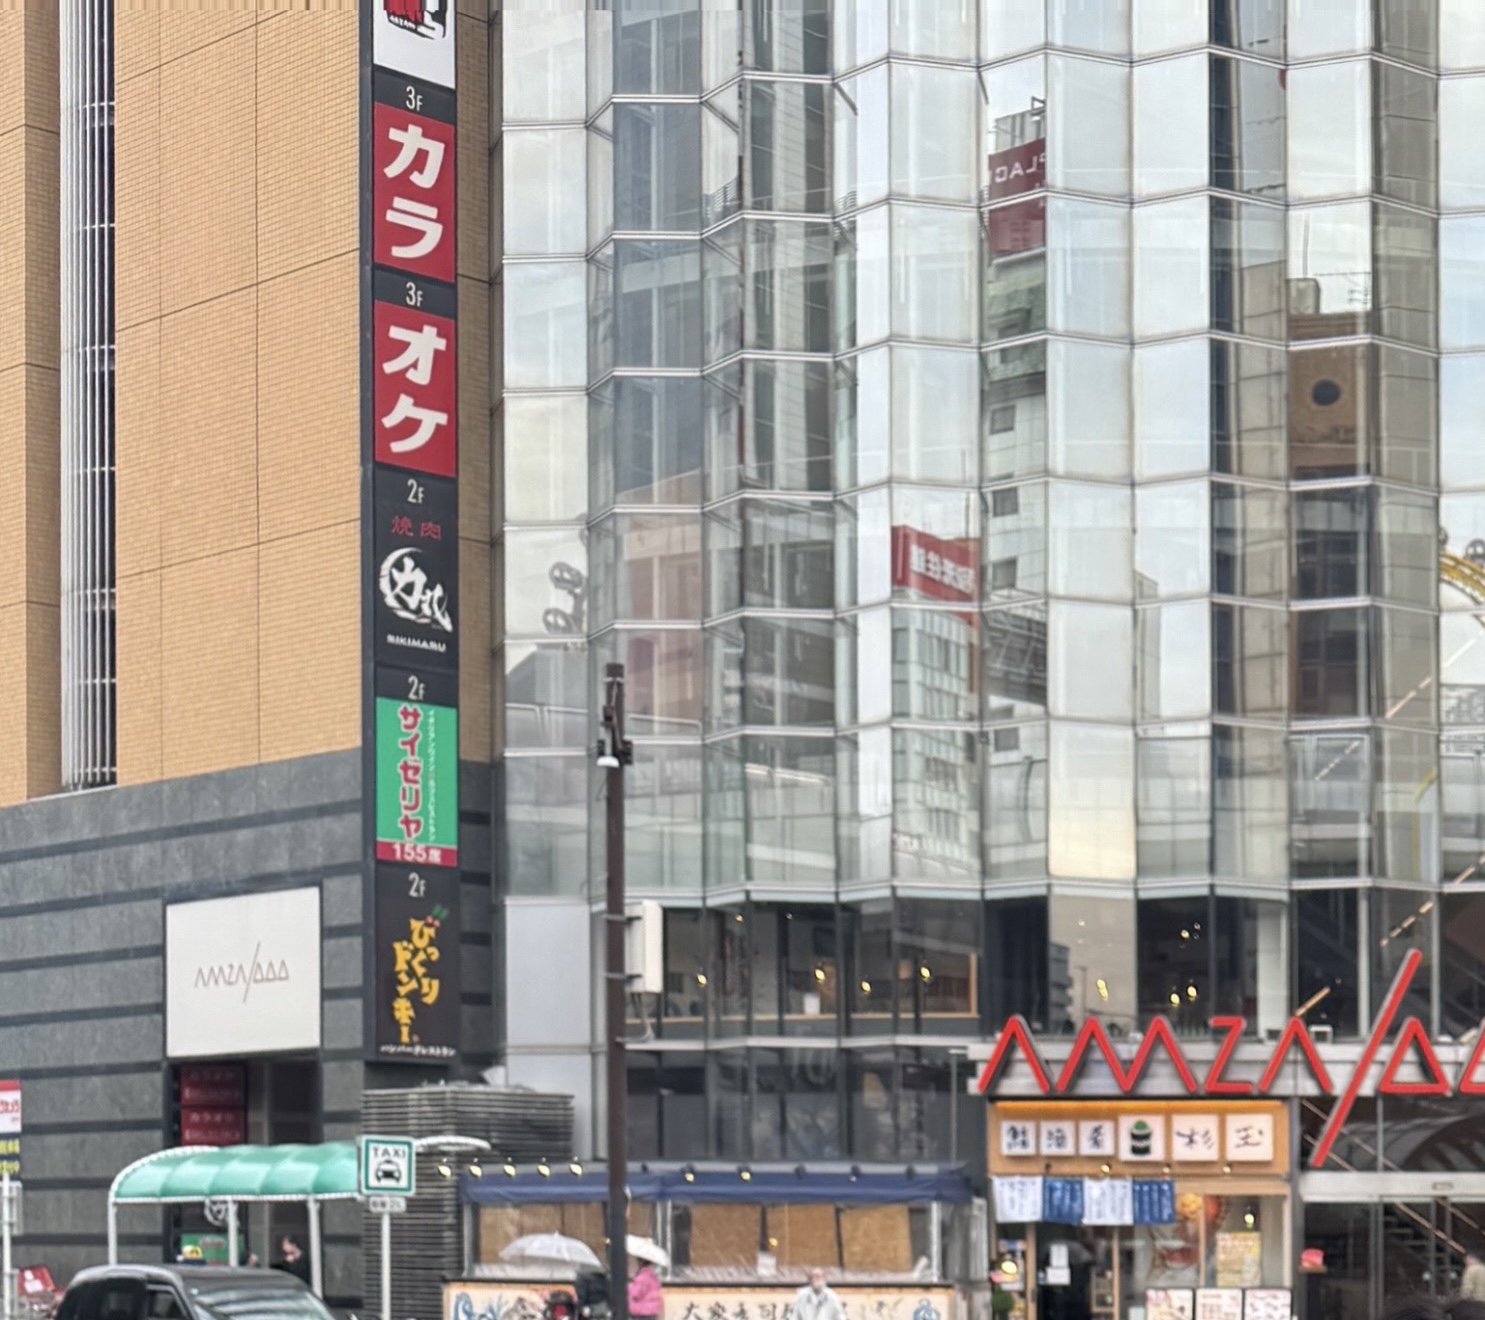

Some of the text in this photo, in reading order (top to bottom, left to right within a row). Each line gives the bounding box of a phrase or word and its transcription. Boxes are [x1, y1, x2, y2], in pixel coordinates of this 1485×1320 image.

[405, 85, 423, 111] 3F
[406, 281, 423, 307] 3F
[407, 478, 425, 504] 2F
[408, 675, 425, 700] 2F
[398, 704, 423, 841] サイゼリヤ
[409, 872, 426, 898] 2F
[373, 1147, 406, 1158] TAXI
